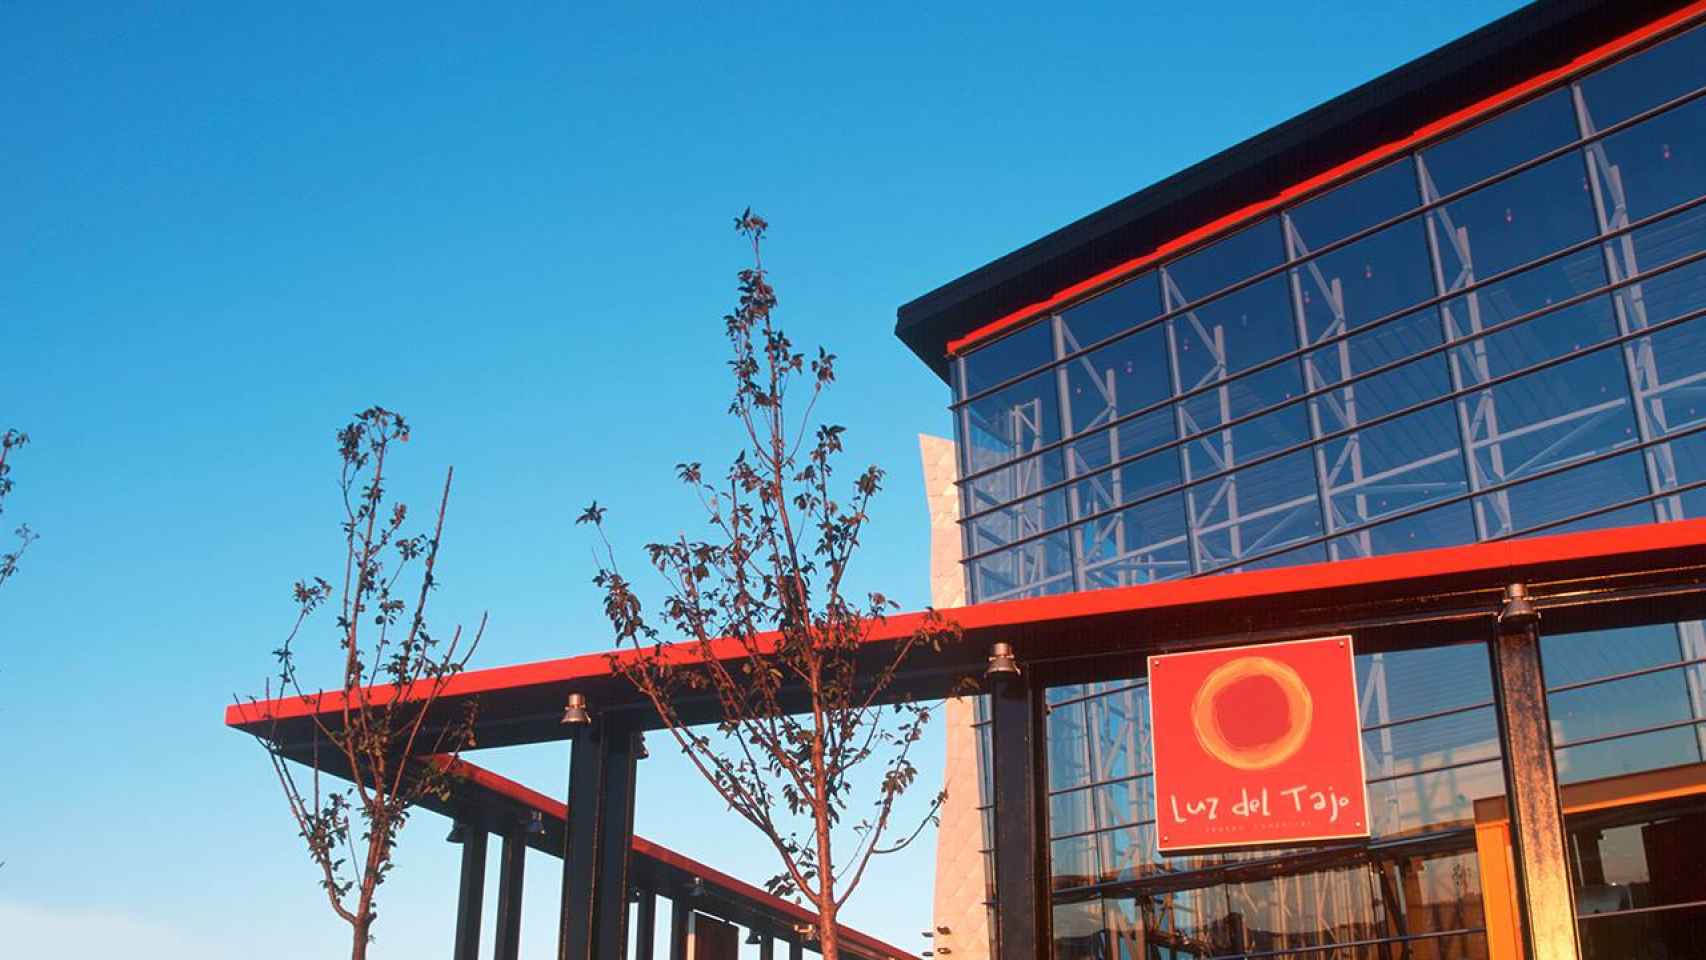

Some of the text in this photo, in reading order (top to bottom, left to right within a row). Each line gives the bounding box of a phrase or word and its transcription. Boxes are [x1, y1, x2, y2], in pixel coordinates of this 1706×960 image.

[1171, 785, 1350, 823] Luz del Tajo
